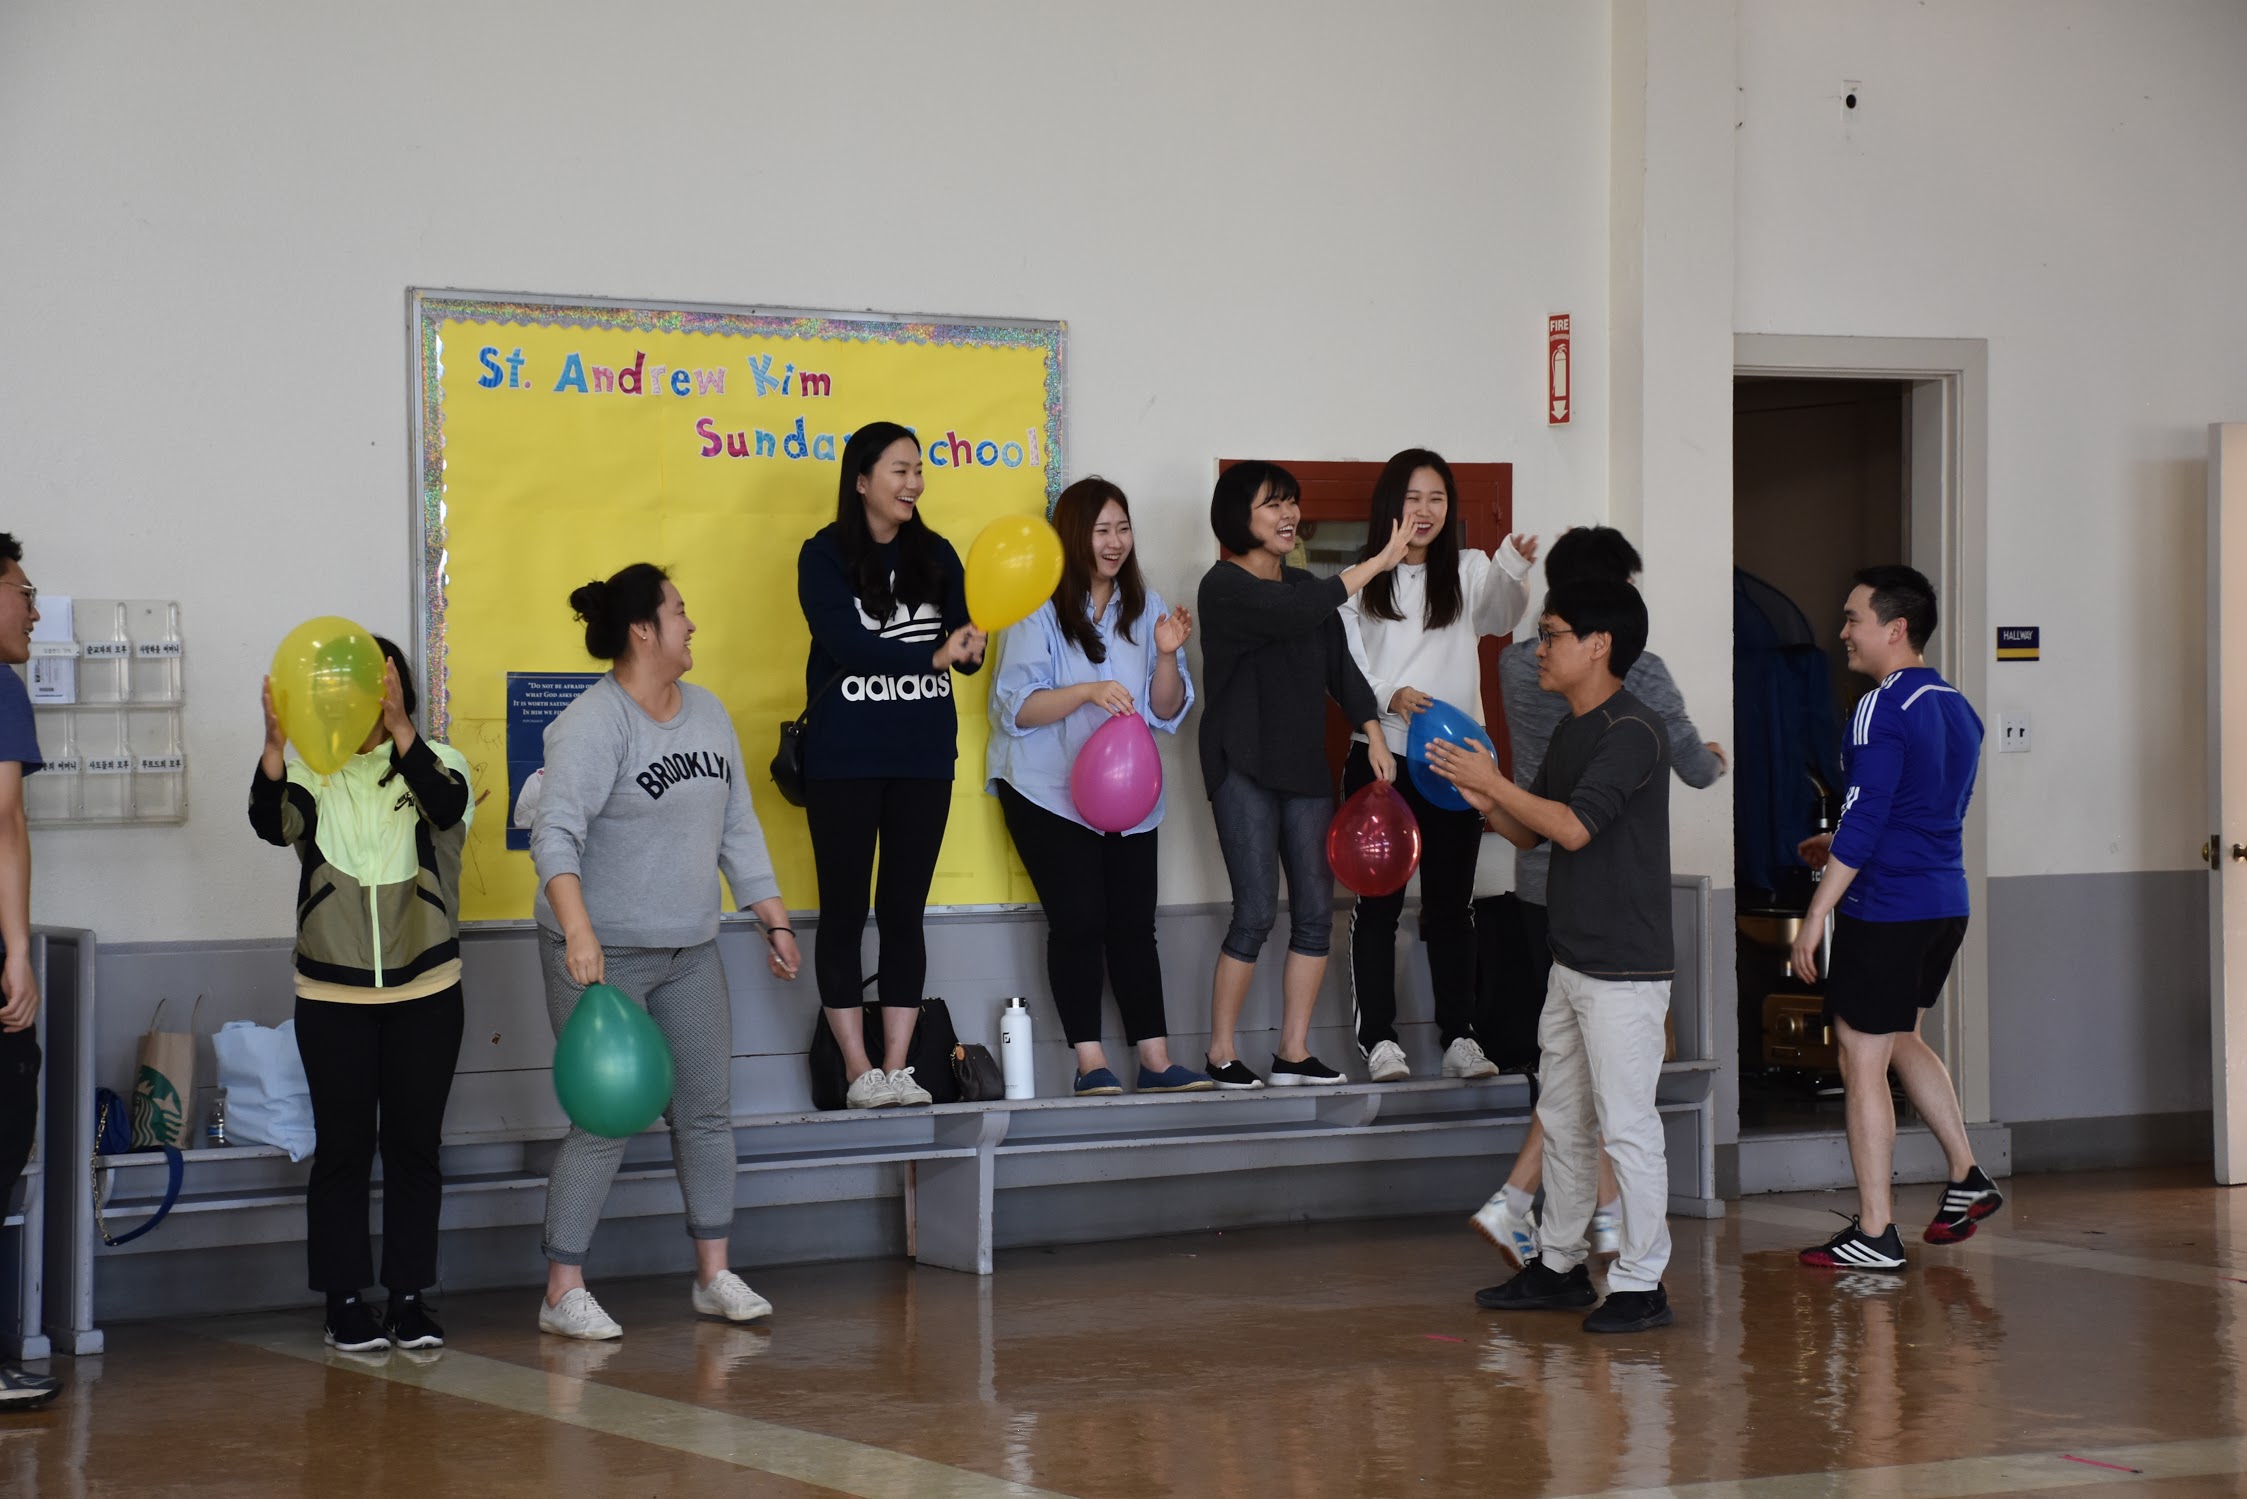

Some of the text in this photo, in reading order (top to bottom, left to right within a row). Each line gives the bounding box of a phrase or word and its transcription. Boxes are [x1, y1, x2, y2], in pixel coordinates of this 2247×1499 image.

[1550, 318, 1569, 332] FIRE
[477, 346, 834, 398] St. Andrew Kim
[694, 415, 1041, 468] Sunda chool
[2003, 630, 2034, 641] HALLWAY
[163, 644, 179, 654] 어머니
[841, 671, 951, 702] adidas
[57, 761, 77, 770] 어머니
[89, 761, 114, 770] 사도들의
